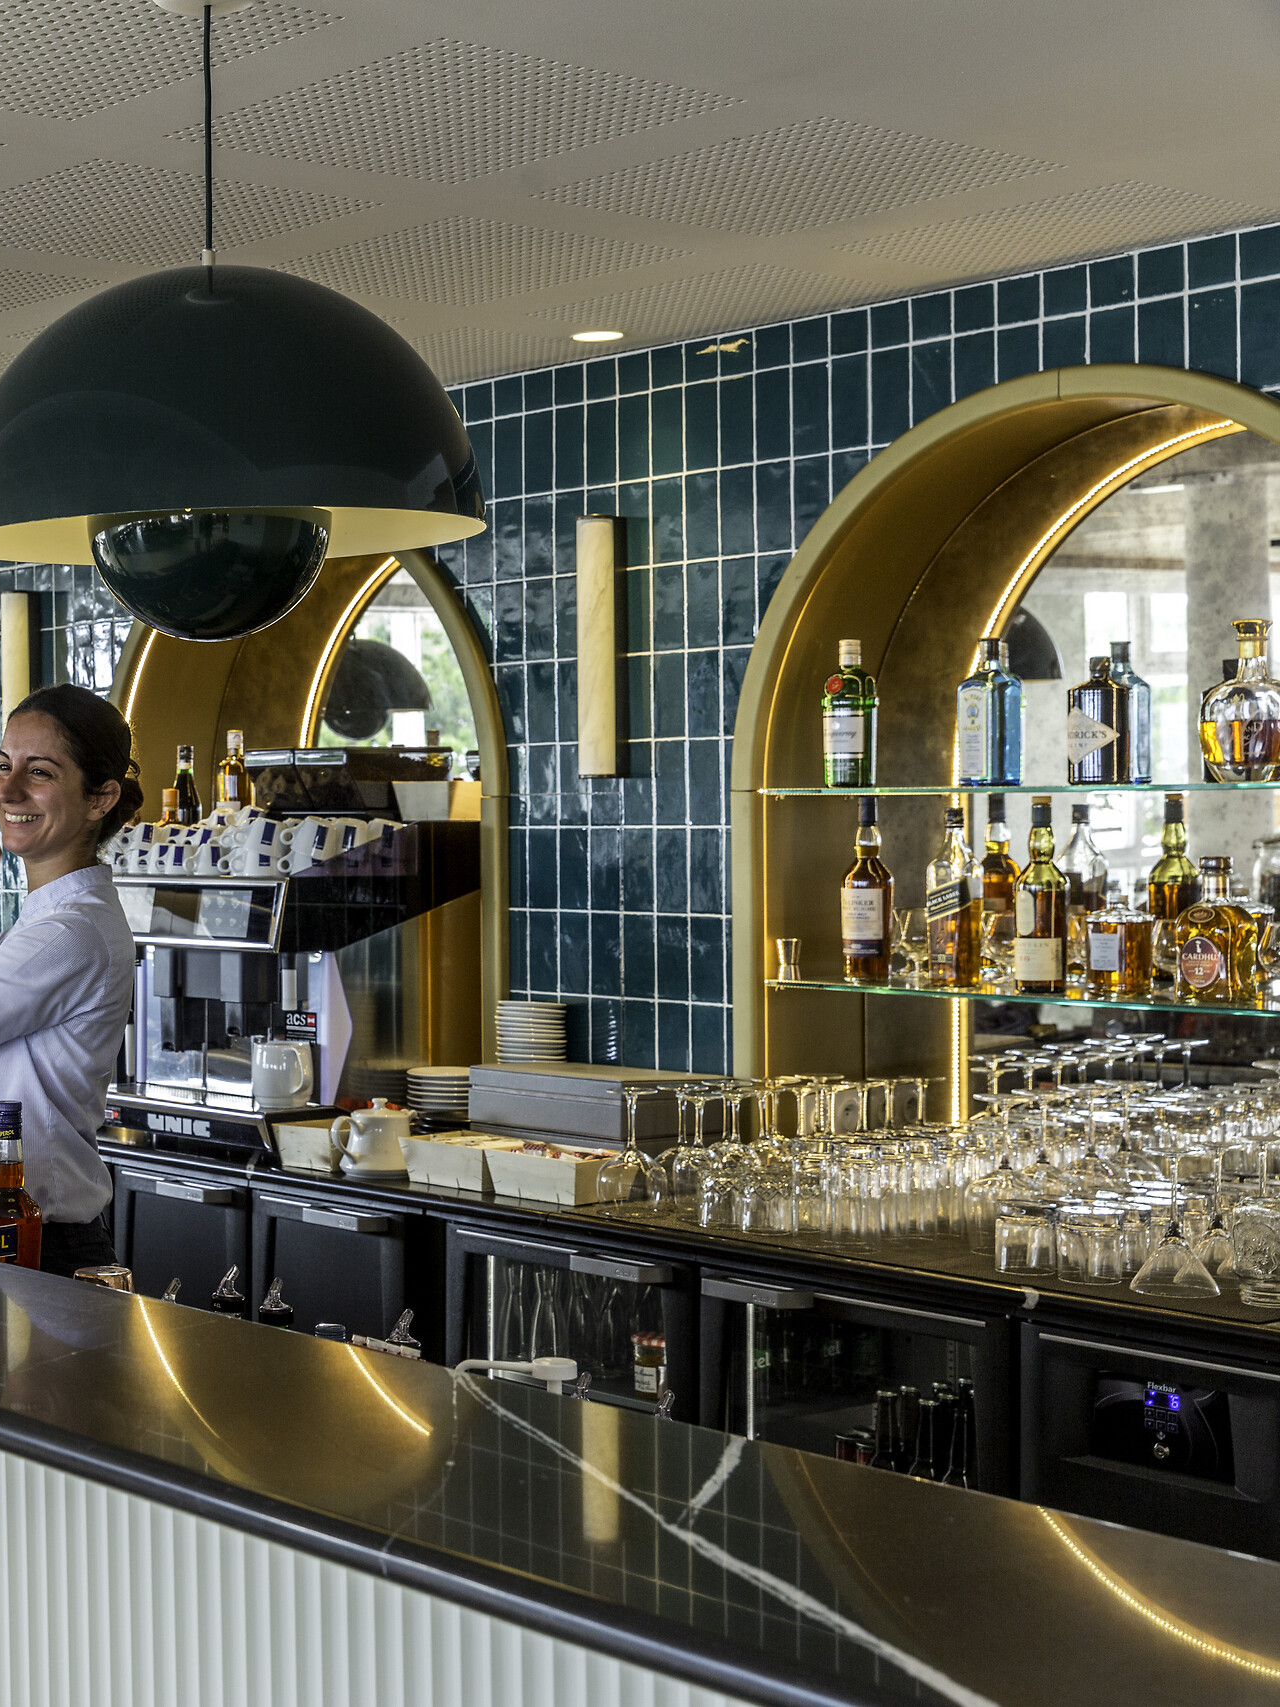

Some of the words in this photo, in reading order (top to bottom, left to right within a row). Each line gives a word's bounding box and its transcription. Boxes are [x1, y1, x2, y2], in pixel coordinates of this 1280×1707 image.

[1194, 967, 1204, 976] 12
[286, 1013, 307, 1026] acs
[147, 1113, 211, 1138] UNIC
[1147, 1381, 1177, 1394] Flexbar
